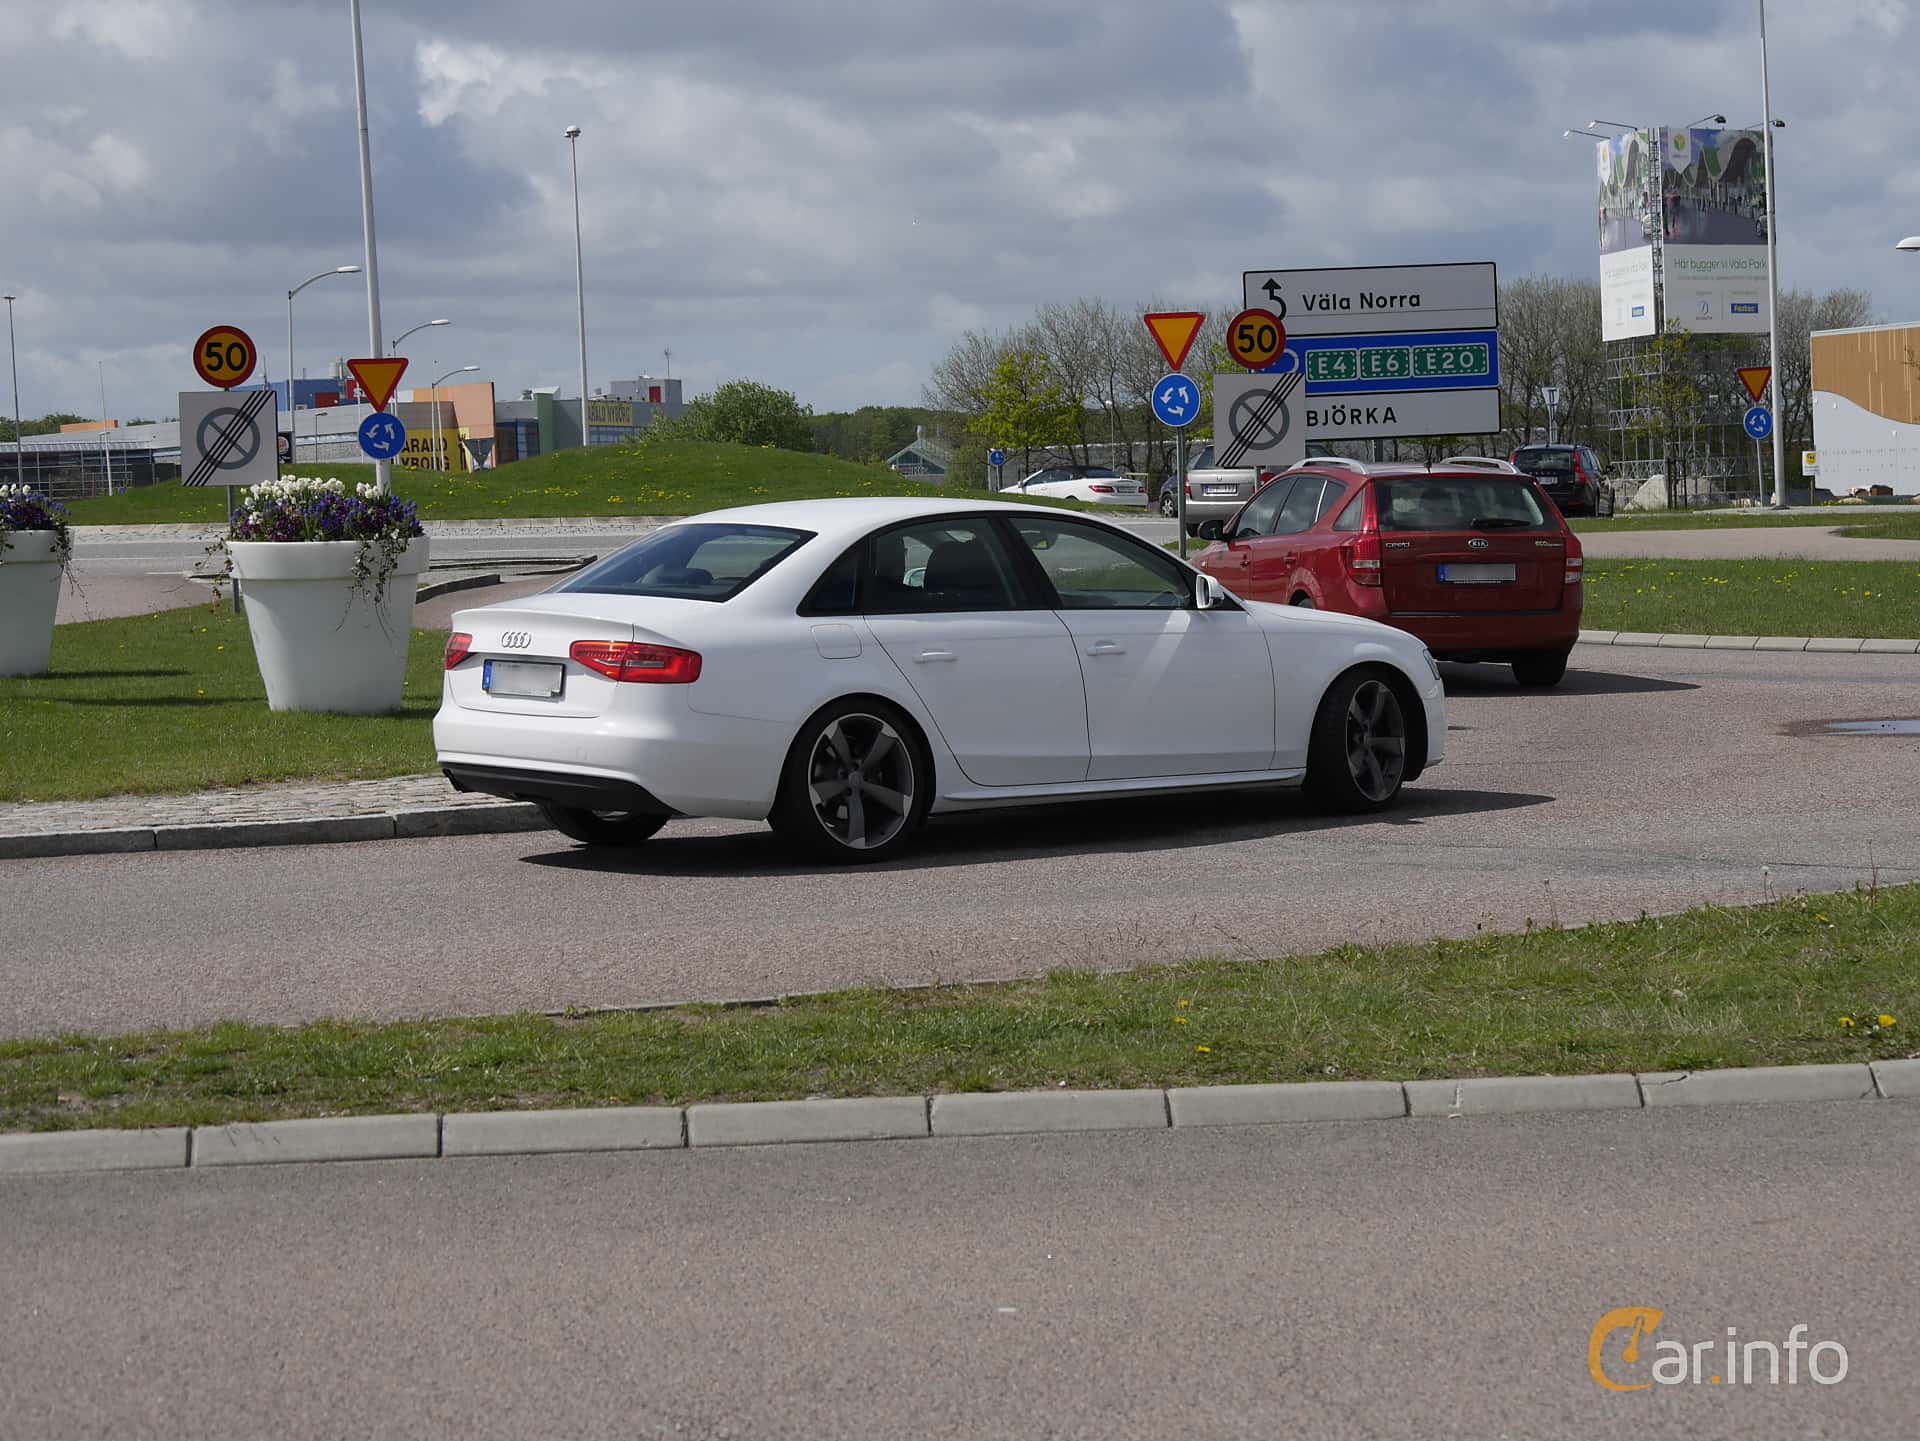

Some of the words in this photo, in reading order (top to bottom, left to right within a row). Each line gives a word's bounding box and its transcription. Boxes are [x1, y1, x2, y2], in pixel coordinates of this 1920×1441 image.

[1690, 257, 1720, 272] bygger
[1748, 257, 1767, 269] Park
[1302, 292, 1351, 312] Väla
[1360, 291, 1421, 310] Norra
[1237, 323, 1278, 354] 50
[203, 341, 248, 372] 50
[1317, 355, 1347, 375] E4
[1370, 352, 1400, 373] E6
[1426, 350, 1476, 370] E20
[1306, 404, 1397, 427] BJÖRKA
